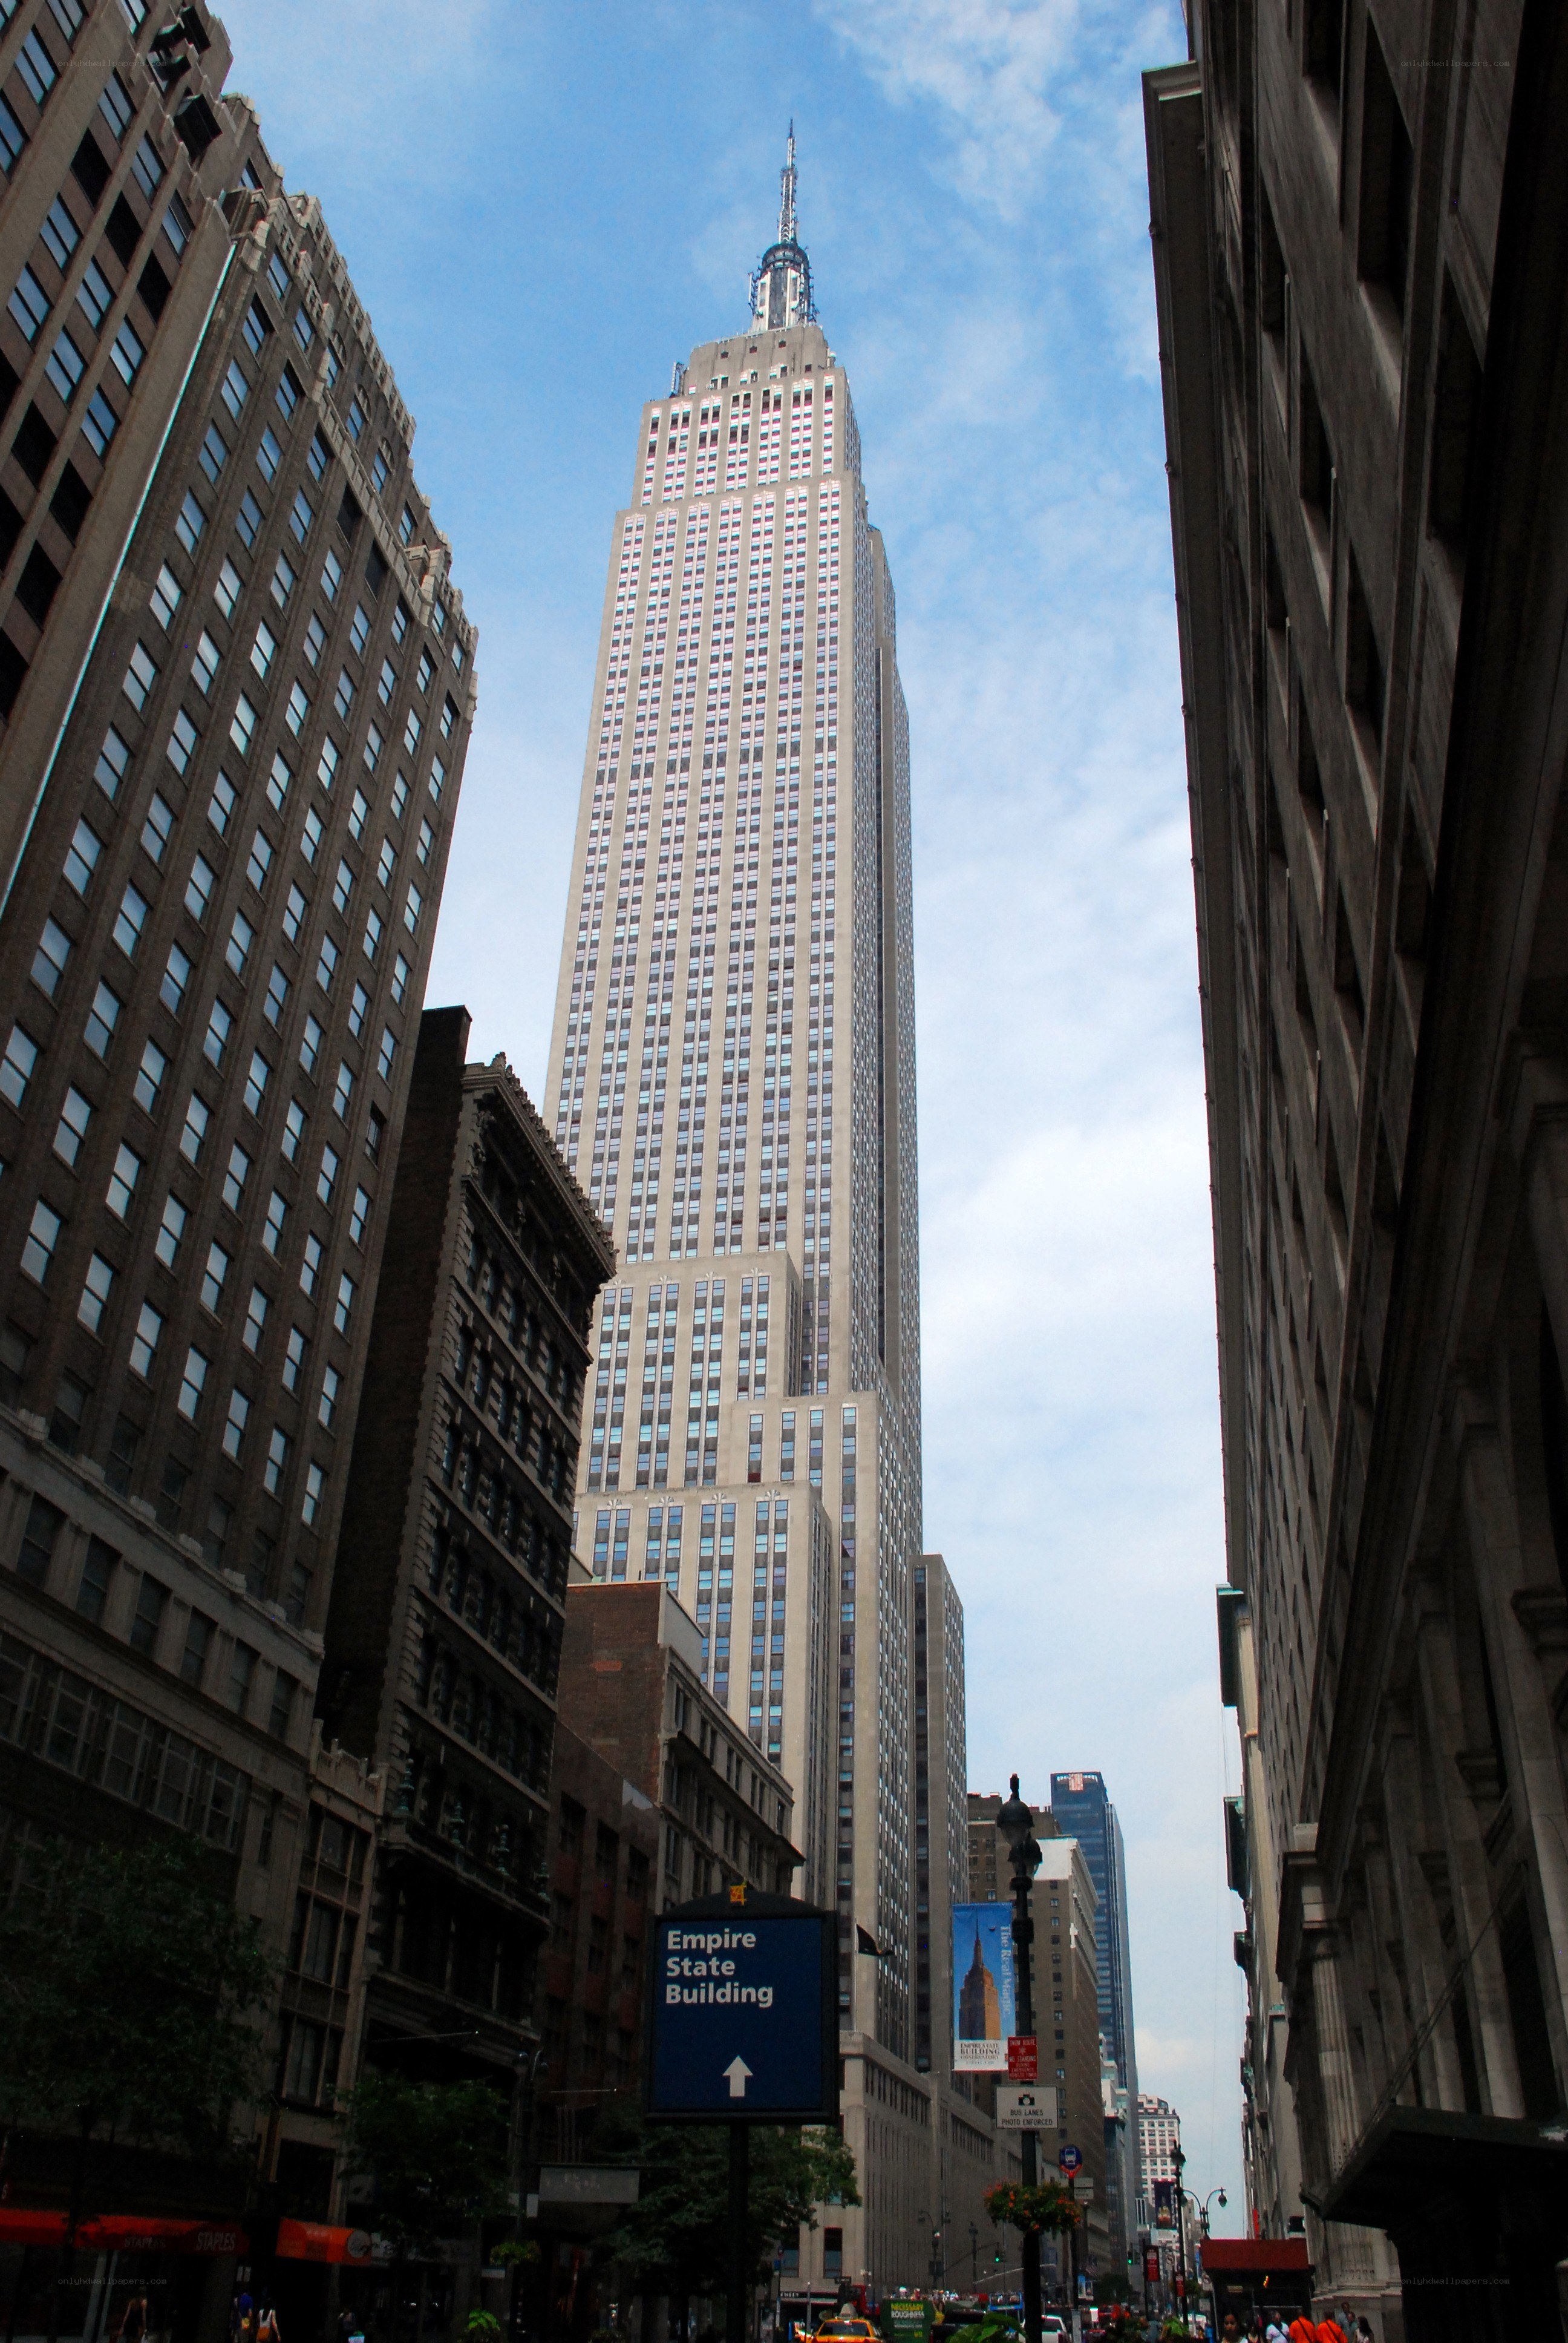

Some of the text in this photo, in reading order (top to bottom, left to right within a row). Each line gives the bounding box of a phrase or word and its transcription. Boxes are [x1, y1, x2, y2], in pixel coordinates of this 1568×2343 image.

[667, 1928, 756, 1953] Empire
[1001, 1925, 1011, 1947] The
[667, 1957, 735, 1976] State
[1001, 1950, 1012, 1975] Real
[666, 1982, 773, 2008] Building
[124, 2236, 166, 2249] STAPLES
[196, 2232, 236, 2251] STAPLES
